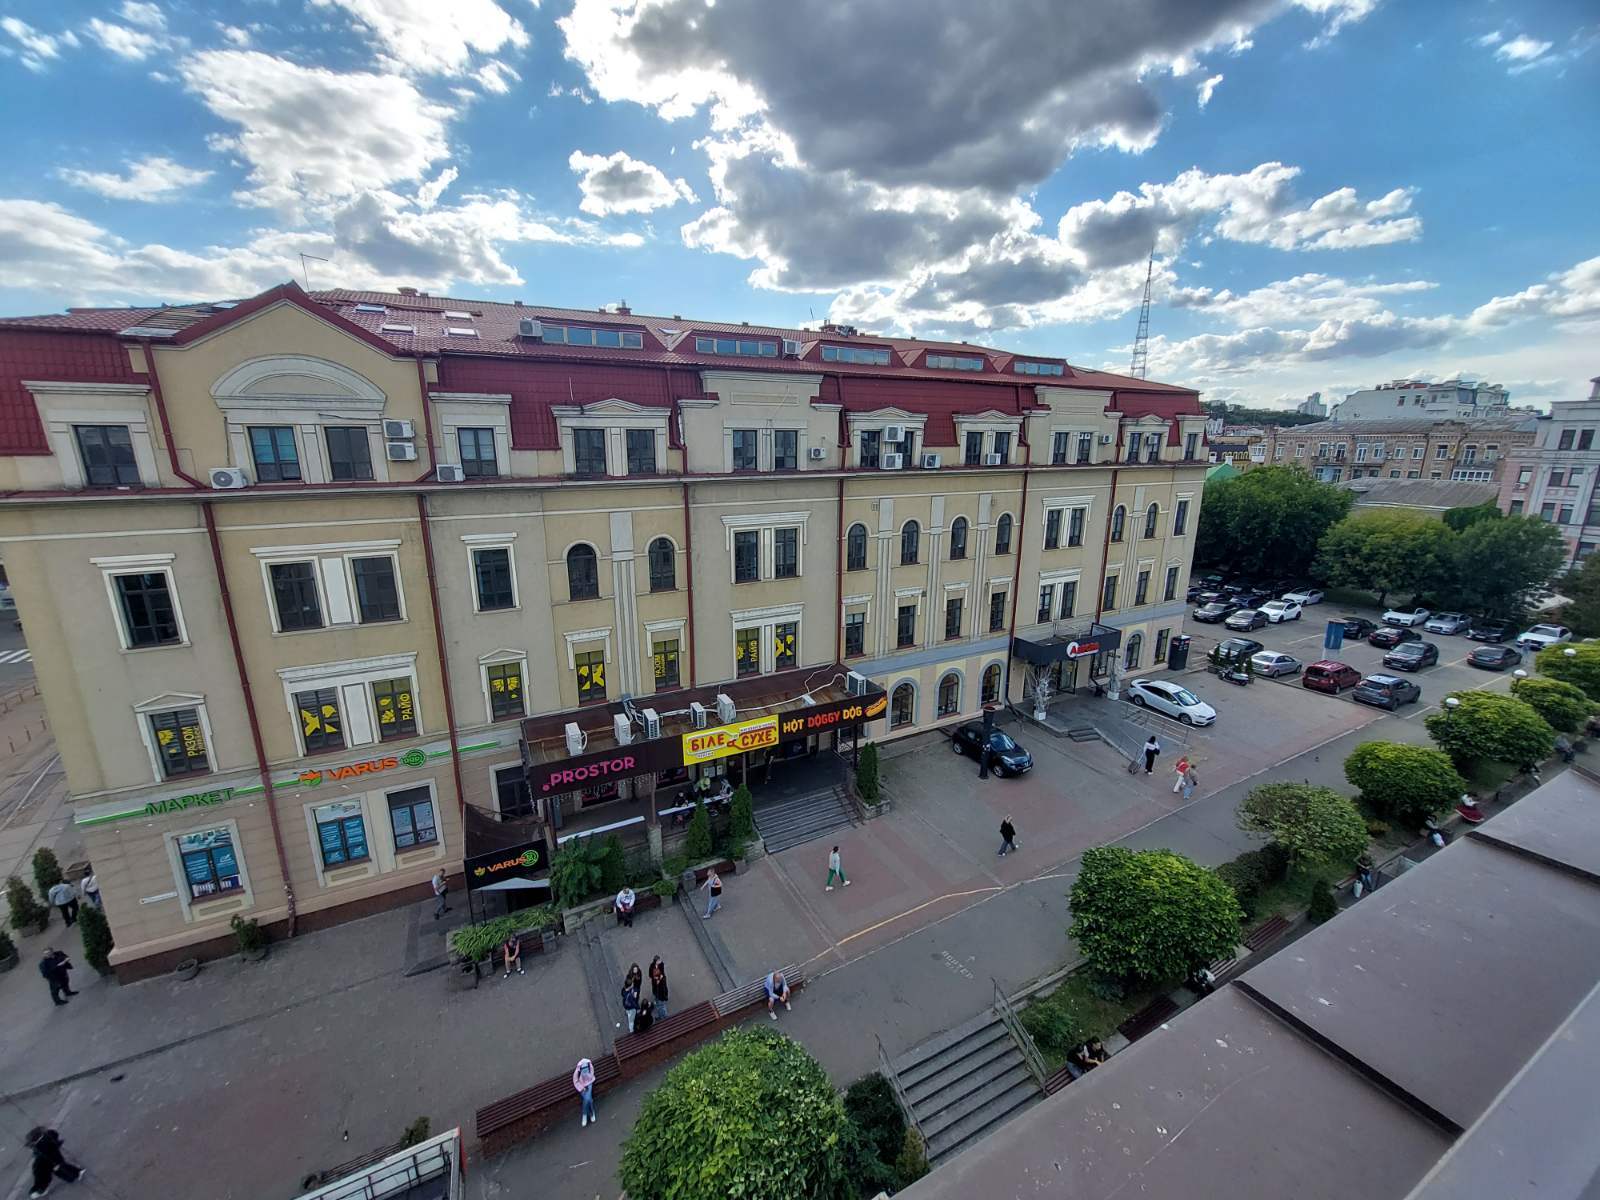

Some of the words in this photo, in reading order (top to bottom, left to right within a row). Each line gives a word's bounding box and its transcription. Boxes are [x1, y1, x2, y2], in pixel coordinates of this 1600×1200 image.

[397, 693, 413, 721] РАЙФ
[782, 718, 805, 734] HOT
[807, 711, 841, 728] DOGGY
[842, 705, 863, 721] DOG
[181, 726, 199, 757] РАЗОМ
[691, 733, 726, 752] БІЛЕ
[741, 728, 774, 747] СУХЕ
[328, 756, 398, 780] VARUS
[145, 787, 234, 816] МАРКЕТ
[486, 855, 528, 873] VARUS
